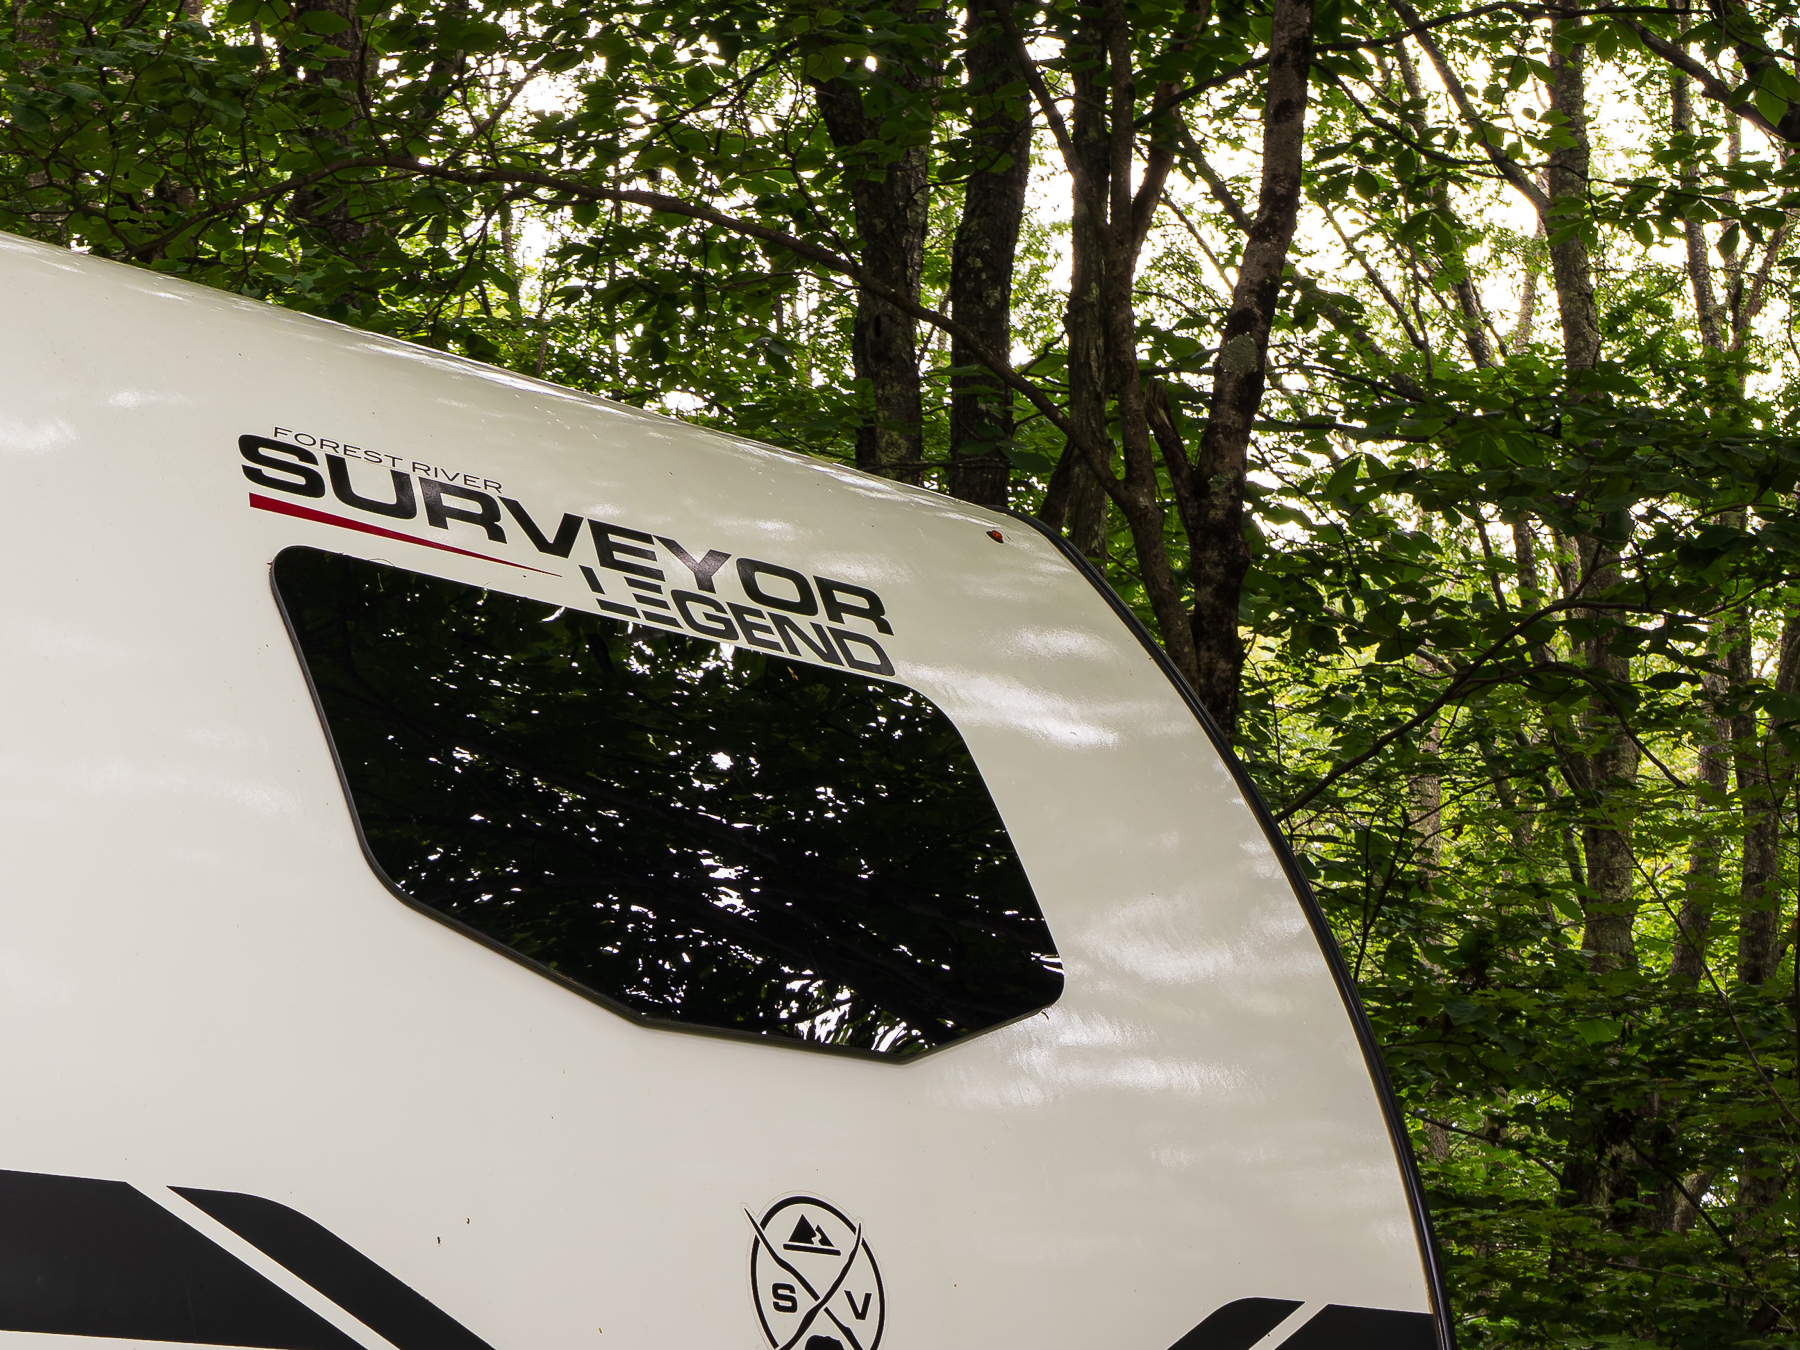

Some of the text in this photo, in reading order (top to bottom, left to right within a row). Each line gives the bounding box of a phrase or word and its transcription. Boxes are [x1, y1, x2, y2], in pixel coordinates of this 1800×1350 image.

[273, 426, 504, 494] FOREST RIVER
[237, 433, 894, 636] SURVEYOR
[578, 564, 896, 677] LEGEND
[772, 1282, 872, 1321] S V
